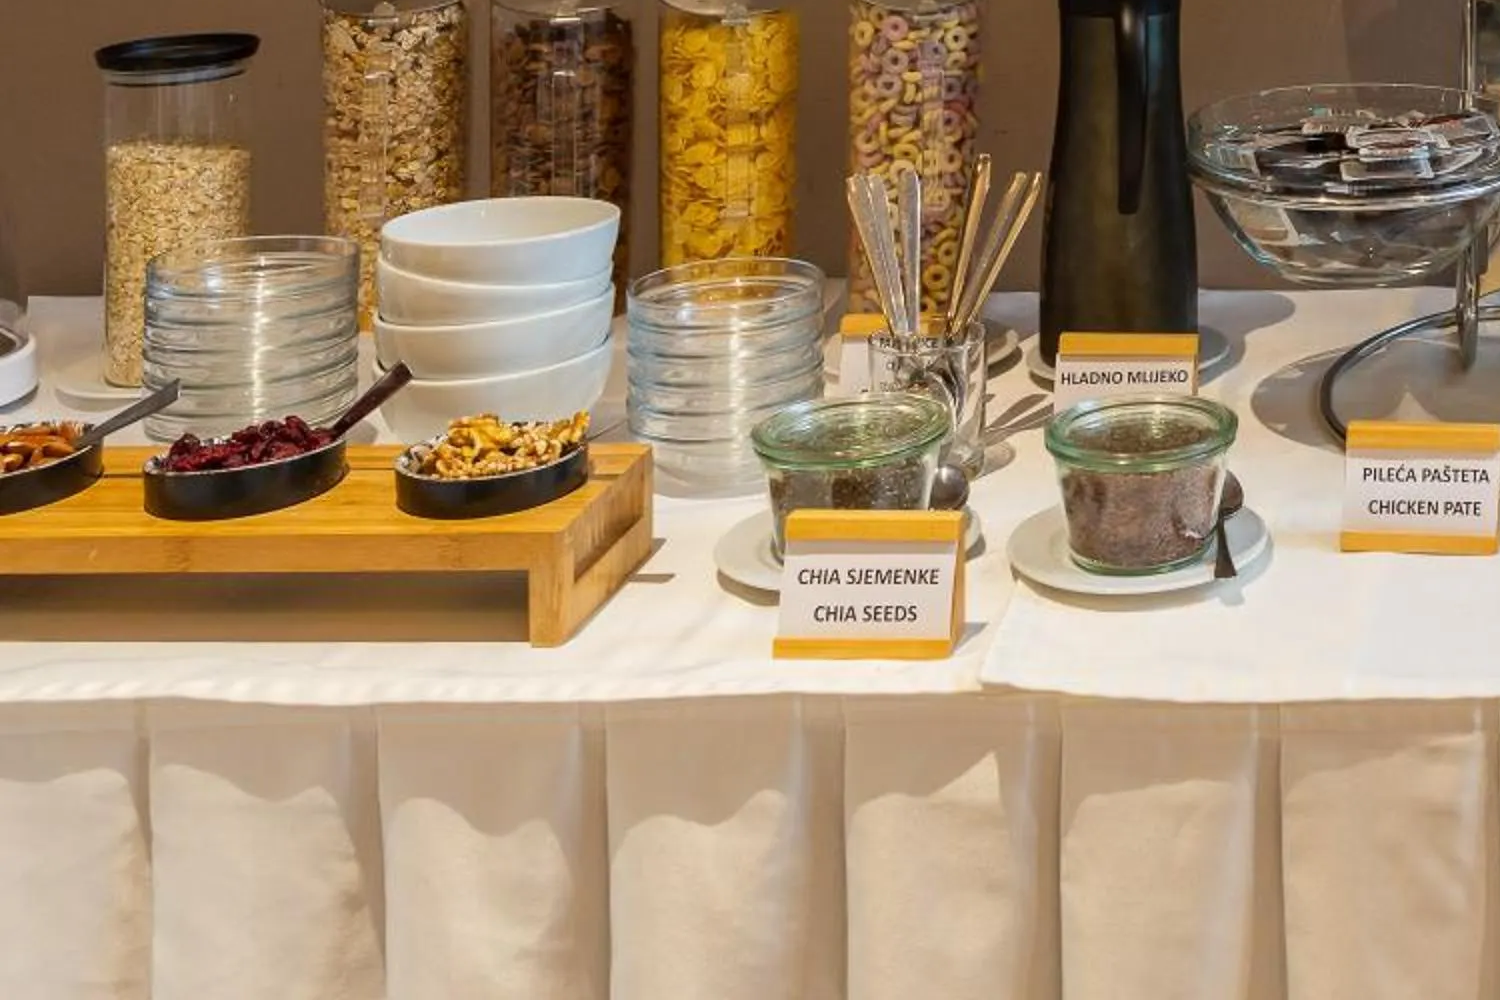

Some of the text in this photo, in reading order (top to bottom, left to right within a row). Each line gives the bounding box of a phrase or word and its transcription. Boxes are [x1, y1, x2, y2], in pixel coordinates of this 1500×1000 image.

[1061, 369, 1189, 385] HLADNO MLIJEKO
[1362, 464, 1490, 484] PILEĆA PAŠTETA
[1368, 500, 1482, 516] CHICKEN PATE
[797, 568, 940, 585] CHIA SJEMENKE
[813, 605, 918, 622] CHIA SEEDS
